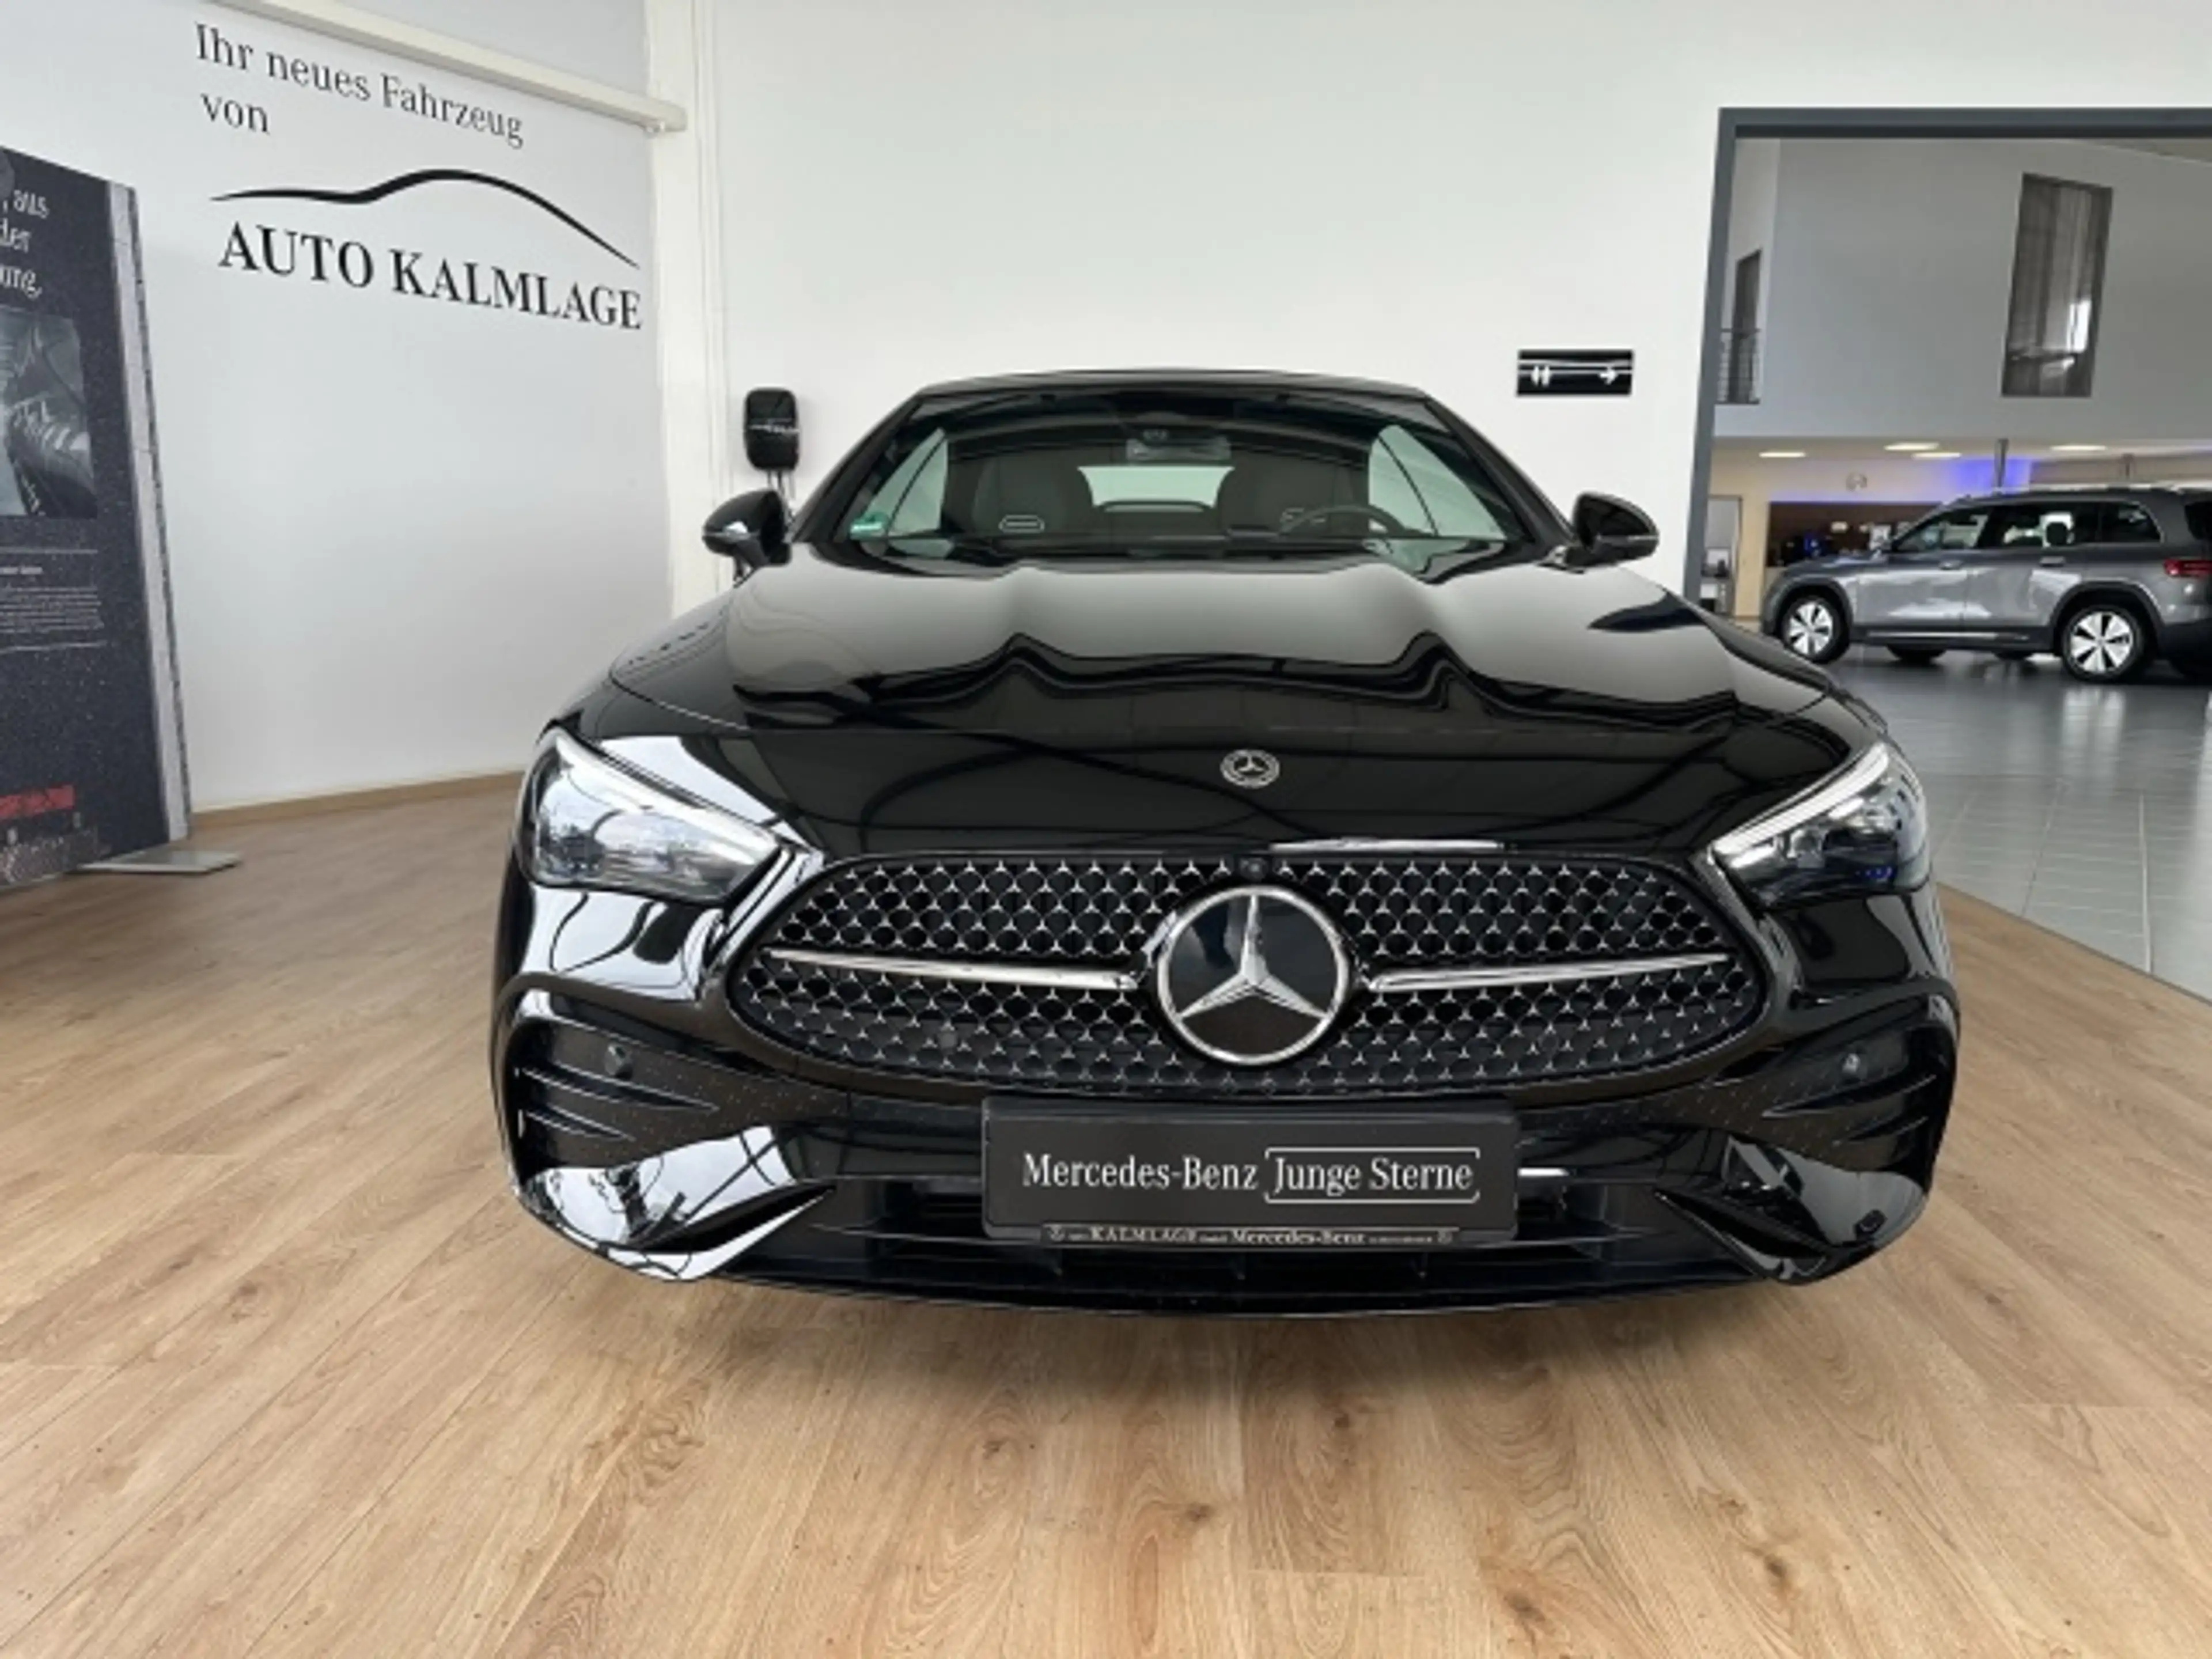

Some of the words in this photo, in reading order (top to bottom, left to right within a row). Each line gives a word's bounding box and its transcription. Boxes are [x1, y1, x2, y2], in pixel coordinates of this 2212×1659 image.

[195, 21, 253, 71] Ihr
[266, 51, 372, 102] neues
[380, 72, 524, 150] Fahrzeug
[200, 93, 270, 135] von
[218, 221, 374, 289] AUTO
[388, 248, 642, 330] KALMLAGE
[1022, 1152, 1260, 1191] Mercedes-Benz
[1273, 1157, 1362, 1198] Junge
[1368, 1156, 1473, 1191] Sterne
